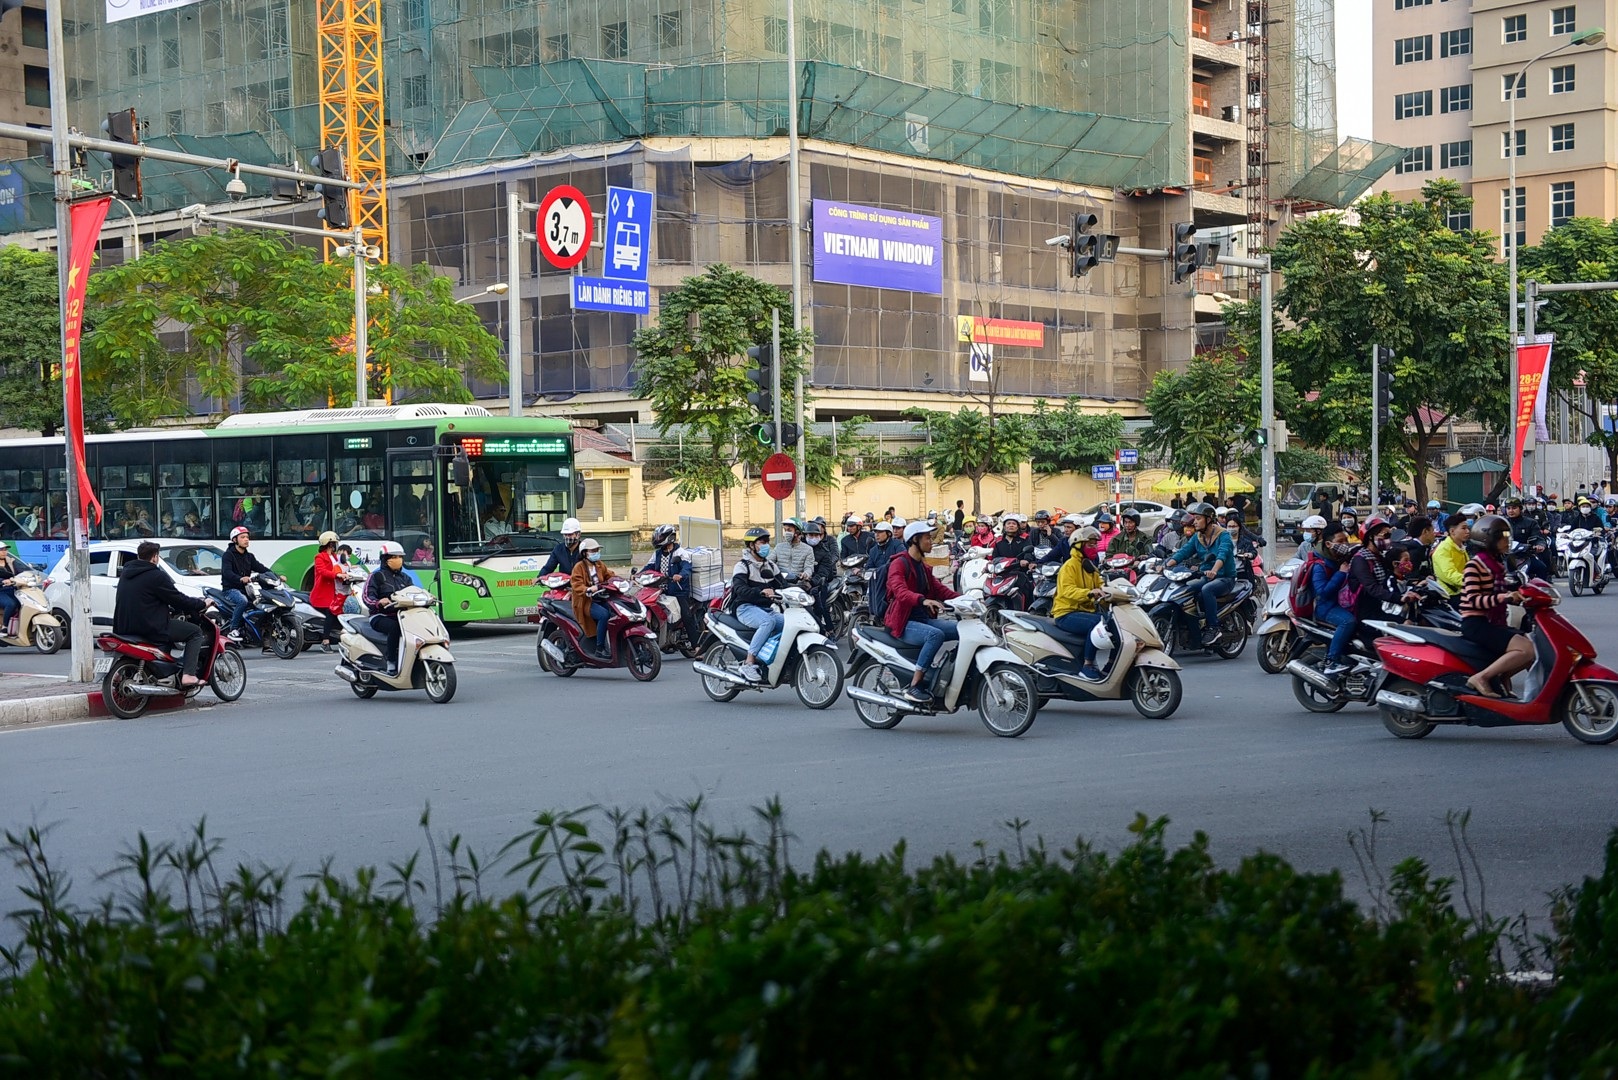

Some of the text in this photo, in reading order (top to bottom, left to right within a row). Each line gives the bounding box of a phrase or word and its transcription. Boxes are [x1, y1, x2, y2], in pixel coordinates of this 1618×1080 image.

[828, 206, 849, 219] CÔNG
[849, 208, 868, 221] TRÌNH
[879, 214, 897, 226] DỤNG
[897, 215, 911, 227] SẢN
[823, 231, 934, 266] VIETNAM WINDOW
[578, 280, 647, 308] LÀN DÀNH RIÊNG BRT
